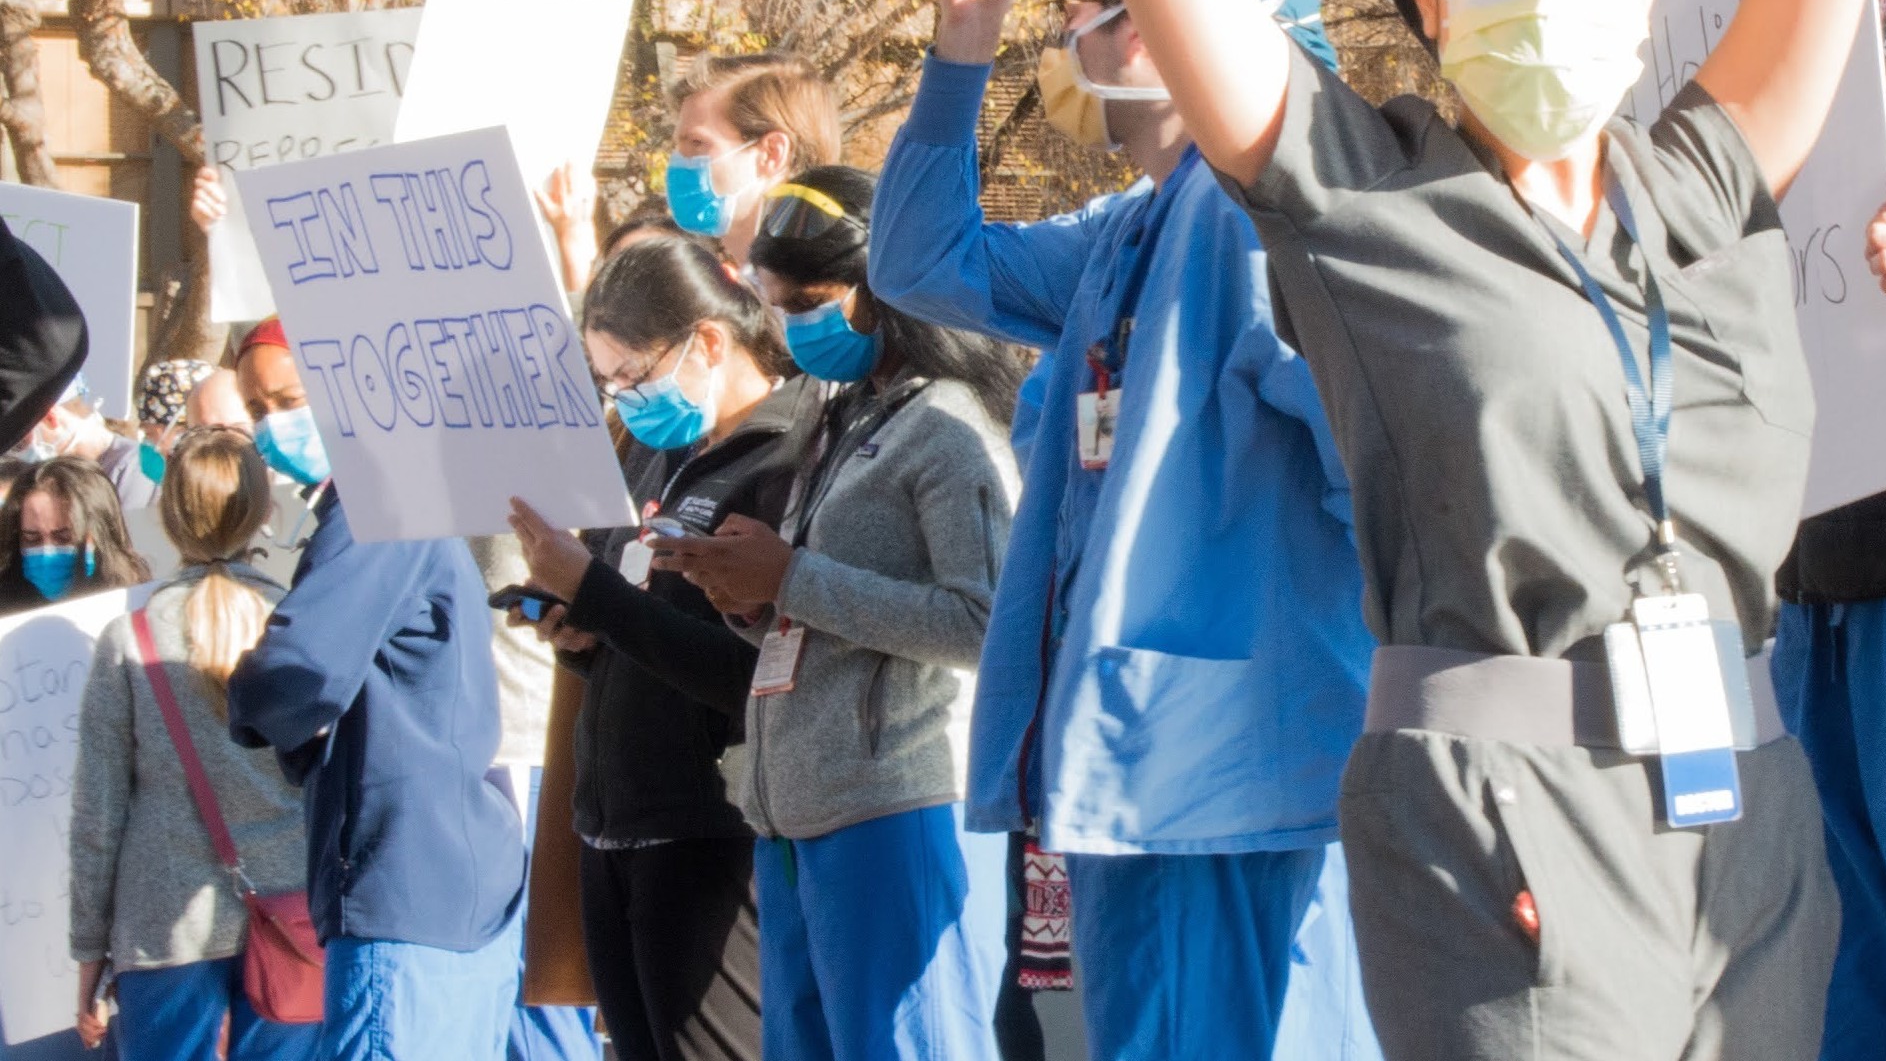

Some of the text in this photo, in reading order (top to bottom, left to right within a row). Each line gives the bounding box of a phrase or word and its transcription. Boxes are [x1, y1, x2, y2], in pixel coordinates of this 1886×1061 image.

[266, 159, 514, 285] IN THIS
[301, 303, 600, 439] TOGETHER
